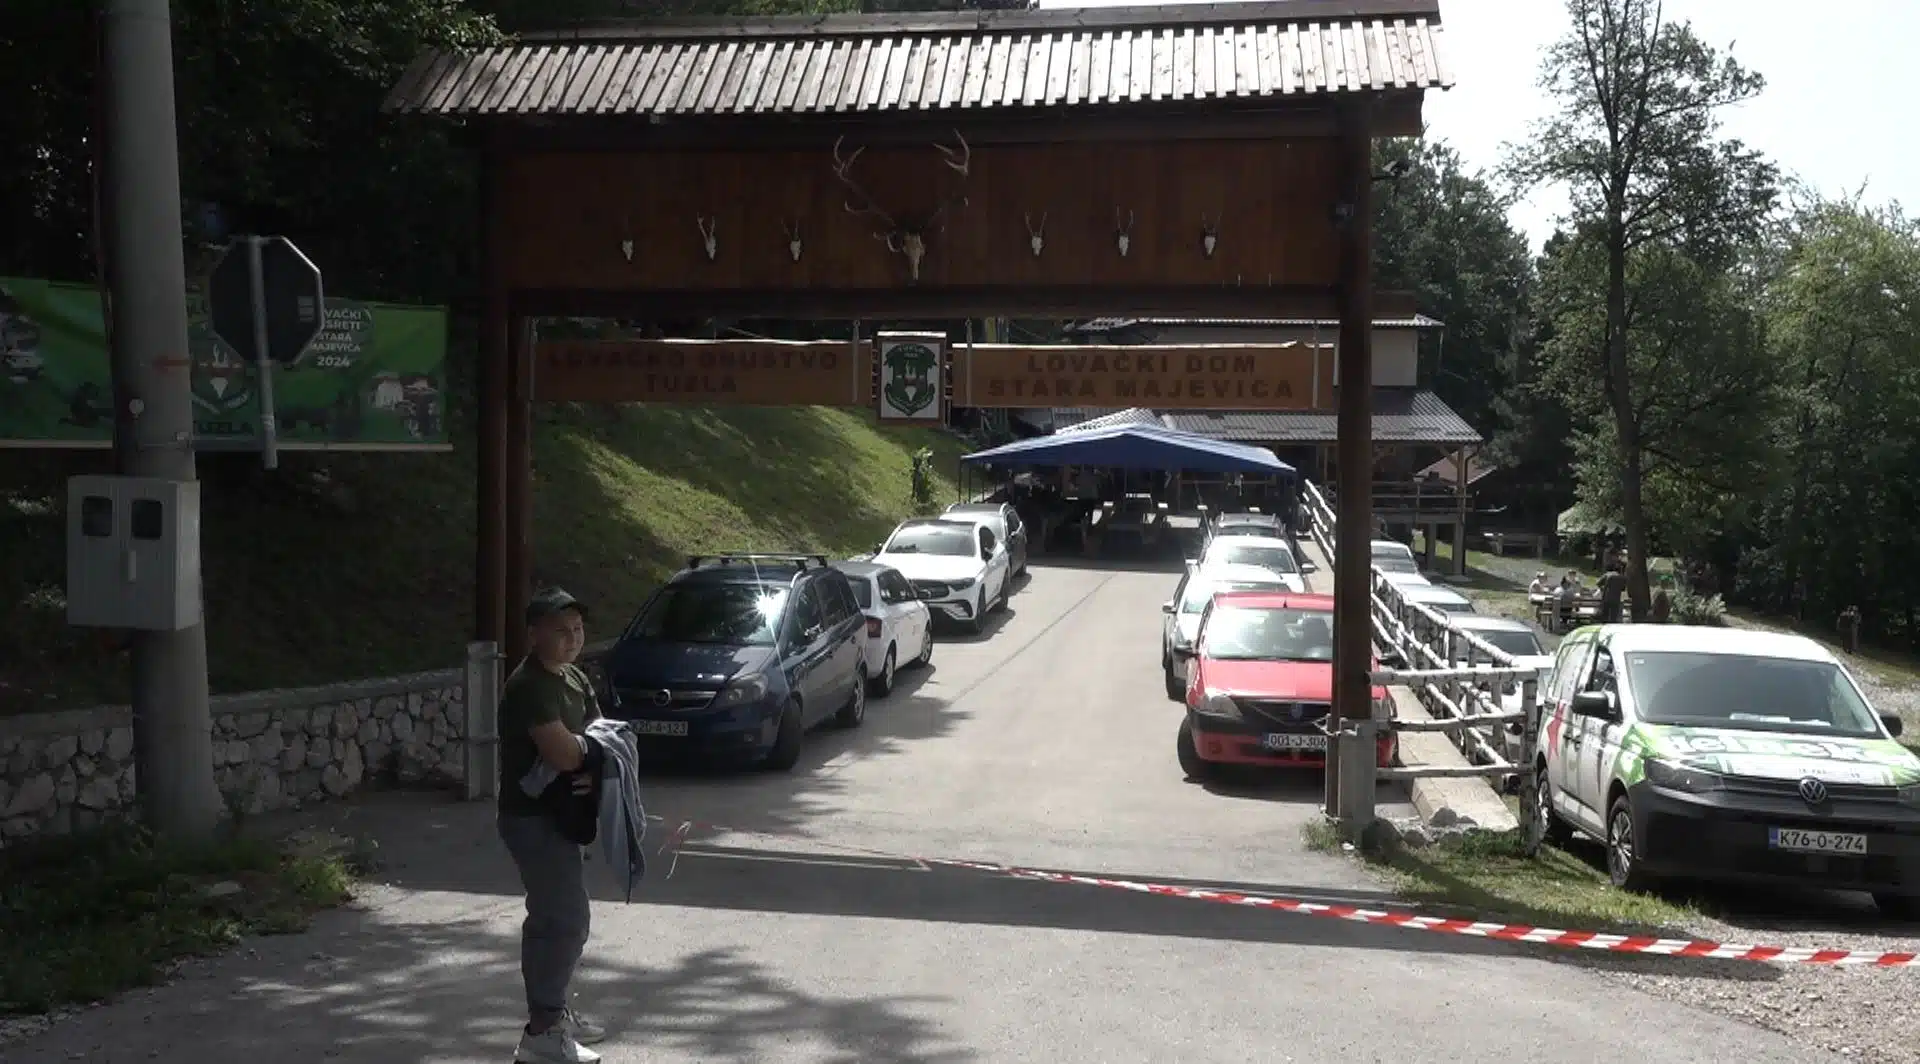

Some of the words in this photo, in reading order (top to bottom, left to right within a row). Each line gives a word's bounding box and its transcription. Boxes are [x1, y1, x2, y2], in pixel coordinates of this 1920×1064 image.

[323, 307, 362, 320] VAČKI
[316, 354, 351, 368] 2024
[1027, 351, 1168, 374] LOVAČKI
[1185, 354, 1256, 374] DOM
[647, 373, 737, 393] TUZLA
[988, 378, 1097, 399] STARA
[1115, 378, 1294, 399] MAJEVICA
